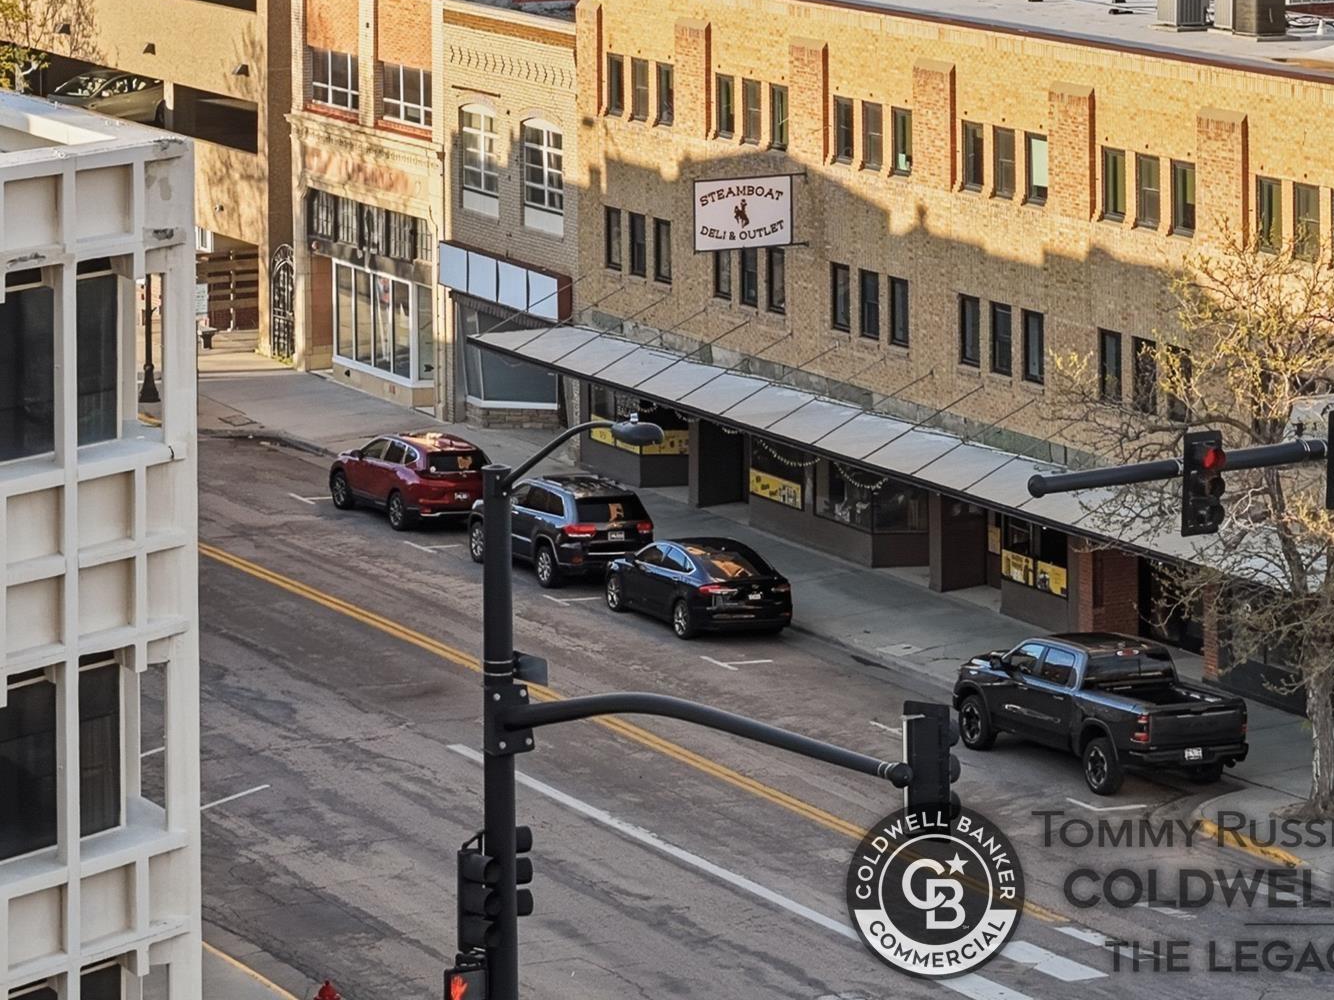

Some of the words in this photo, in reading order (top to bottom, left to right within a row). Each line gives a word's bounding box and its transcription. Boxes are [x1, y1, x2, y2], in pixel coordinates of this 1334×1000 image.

[699, 185, 784, 207] STEAMBOAT
[700, 225, 726, 240] DELI
[728, 231, 737, 240] &
[739, 219, 785, 240] OUTLET
